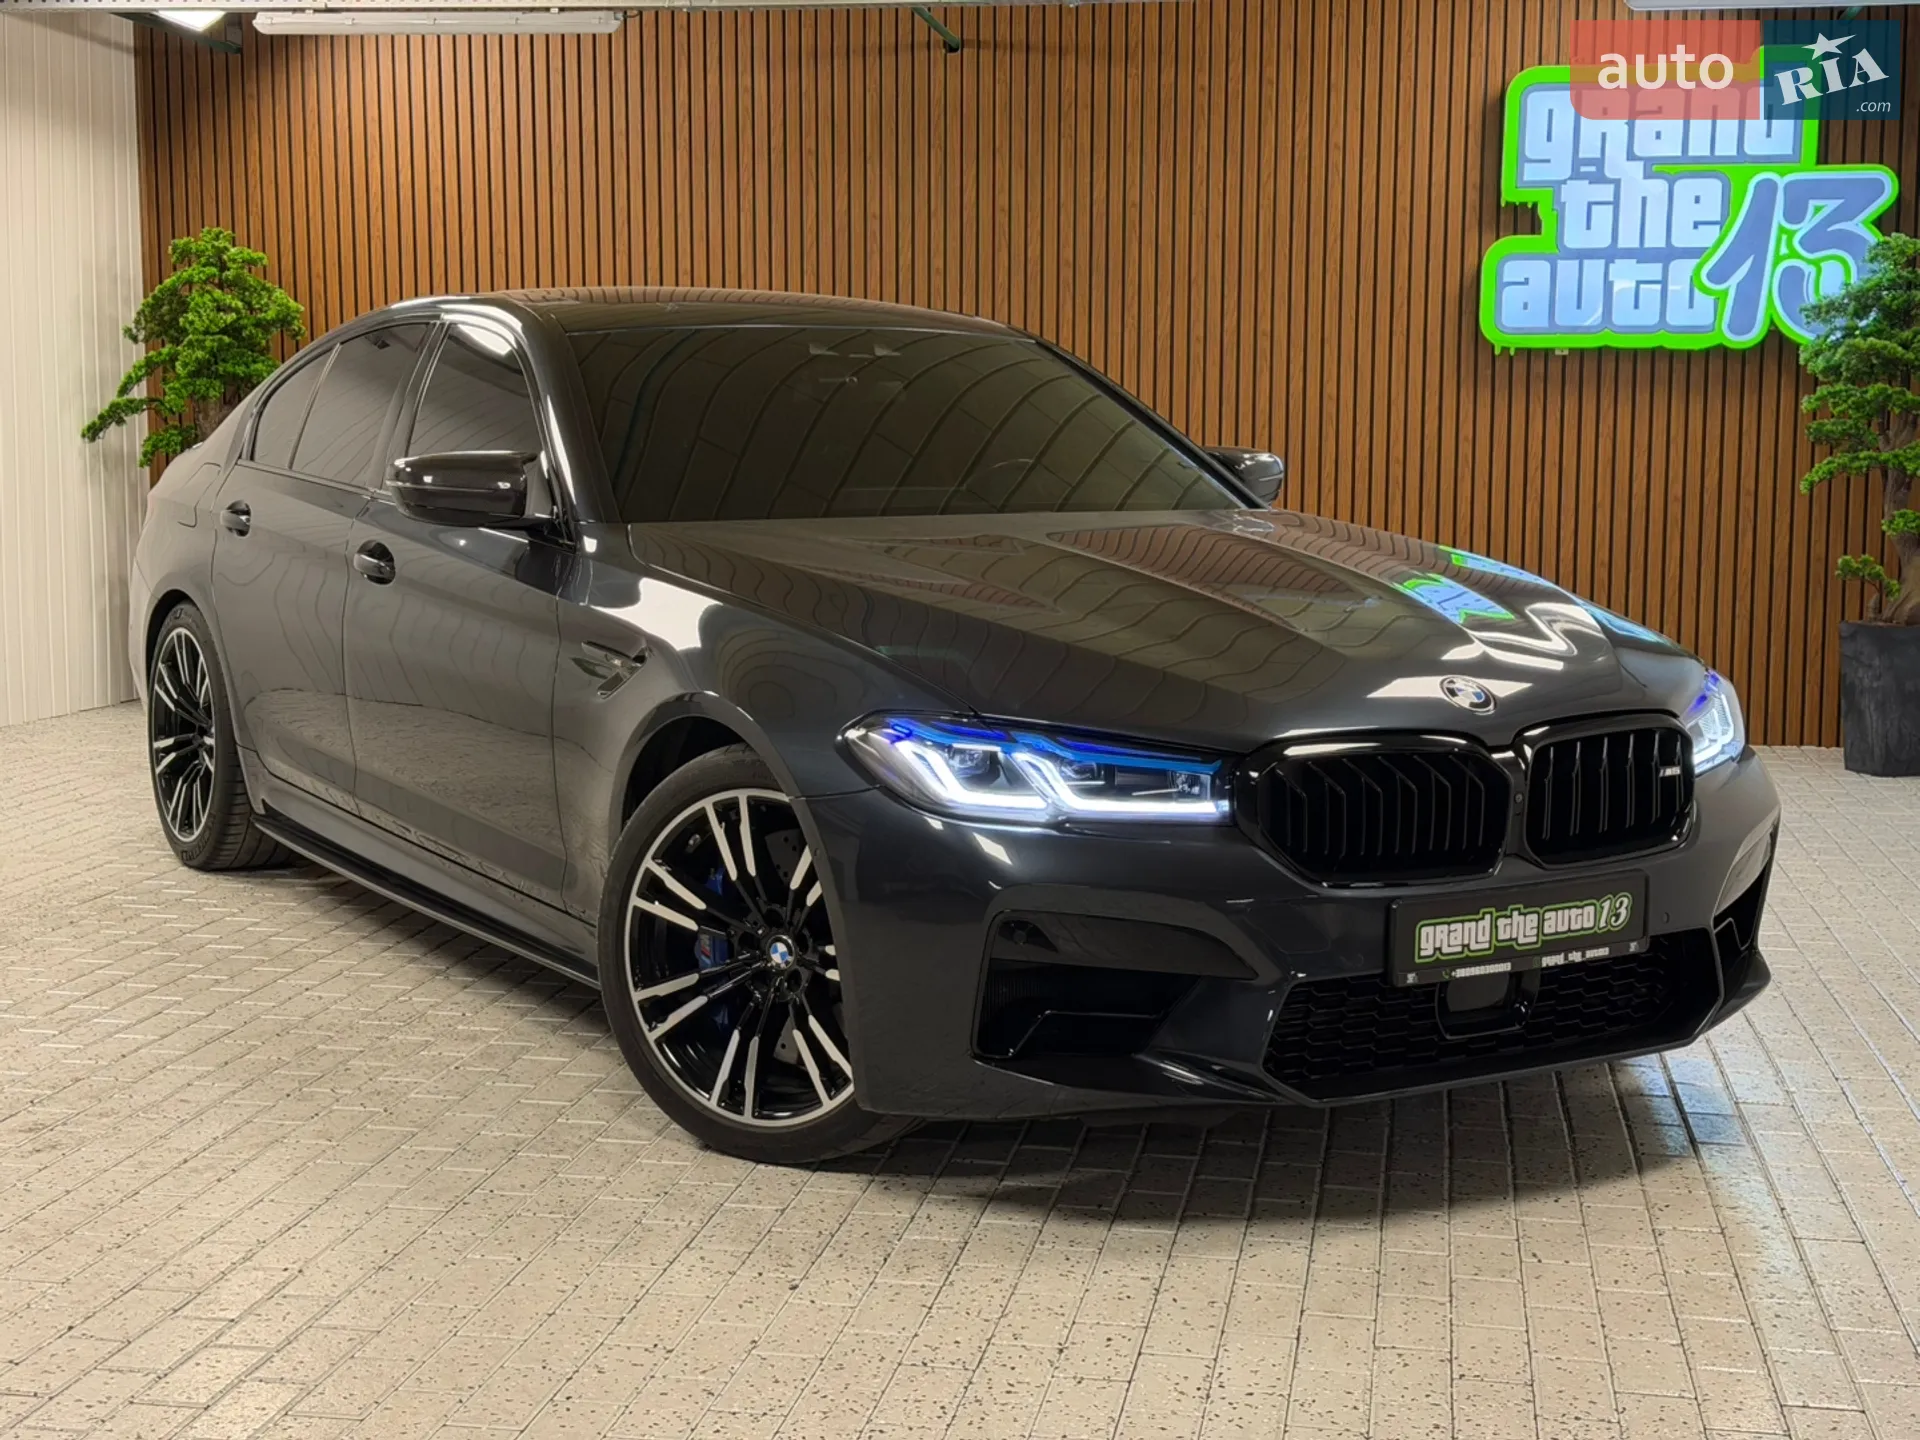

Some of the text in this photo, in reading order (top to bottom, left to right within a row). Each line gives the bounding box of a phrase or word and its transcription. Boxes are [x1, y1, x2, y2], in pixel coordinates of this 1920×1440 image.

[1560, 161, 1723, 249] the
[1500, 258, 1717, 328] auto
[1700, 172, 1892, 342] 13
[1497, 910, 1538, 945] the
[1543, 905, 1595, 934] auto
[1600, 897, 1628, 927] 13
